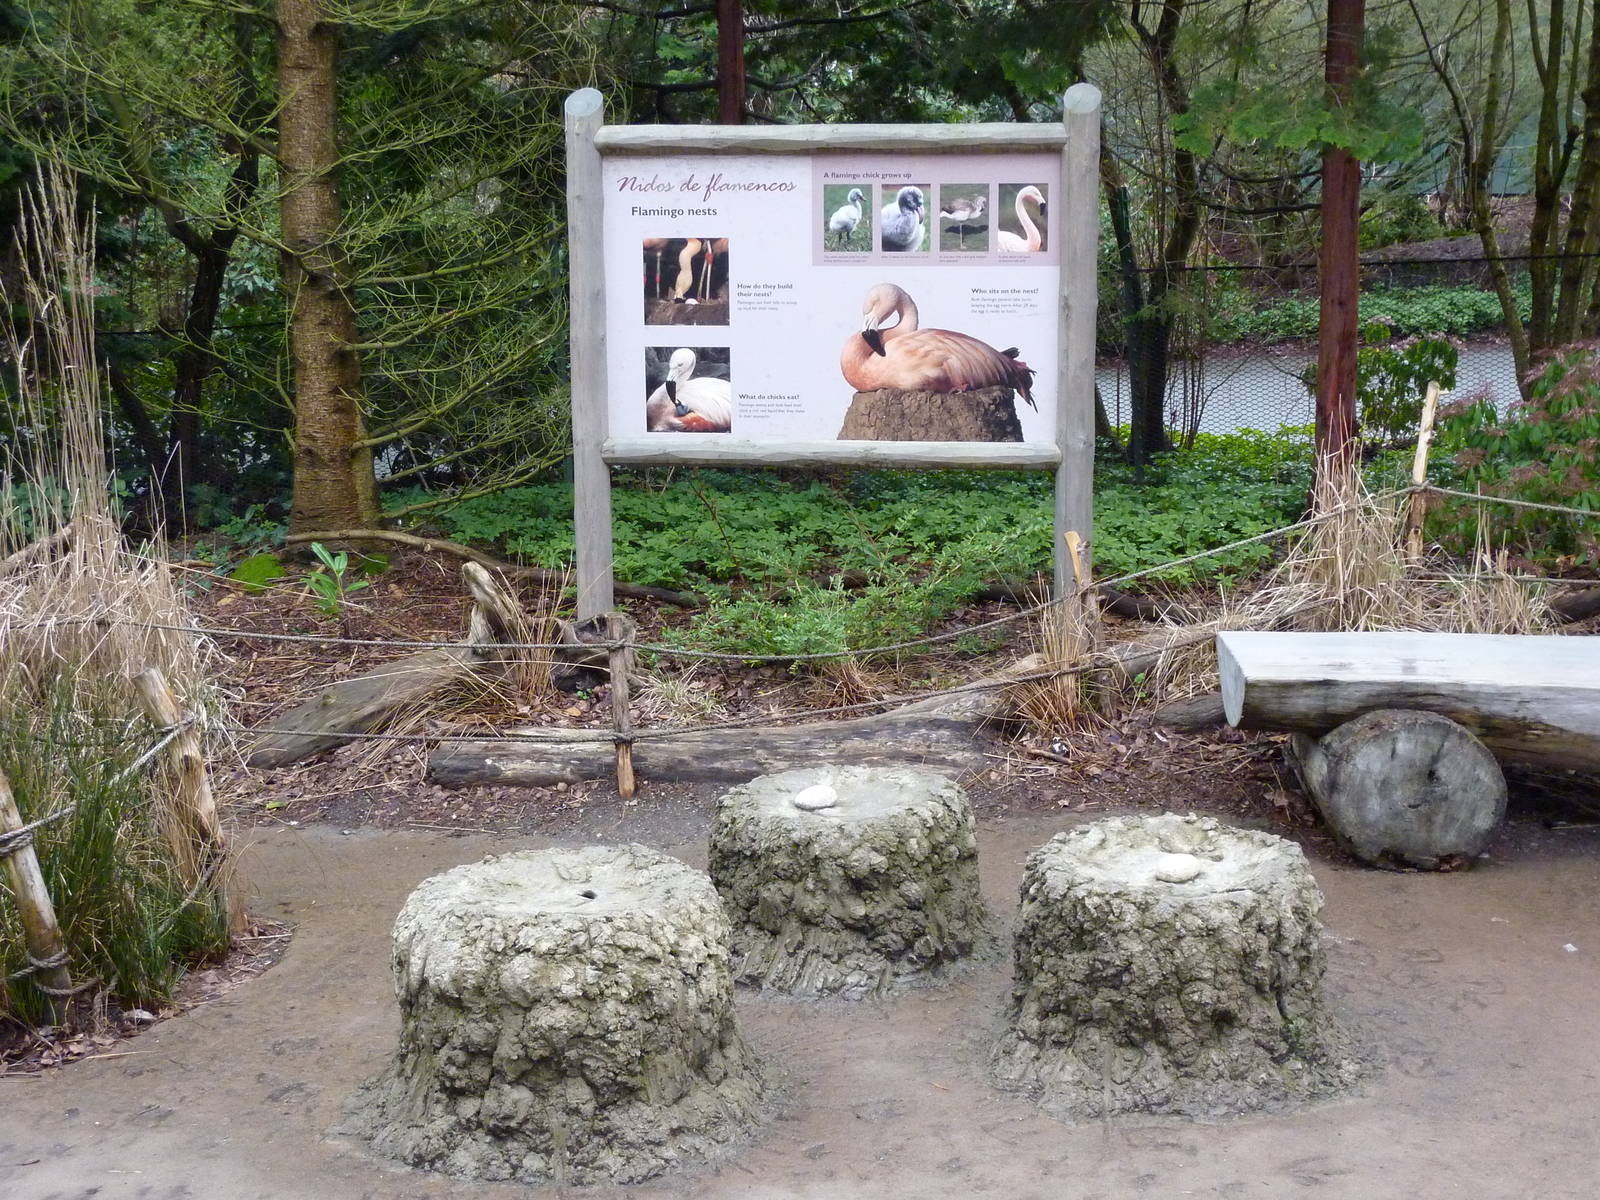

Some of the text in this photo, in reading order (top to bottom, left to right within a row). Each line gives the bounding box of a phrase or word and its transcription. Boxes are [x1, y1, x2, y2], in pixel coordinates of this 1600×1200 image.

[831, 171, 861, 180] flamingo
[617, 173, 797, 202] Nidos de flamencos
[631, 206, 718, 219] Flamingo nests
